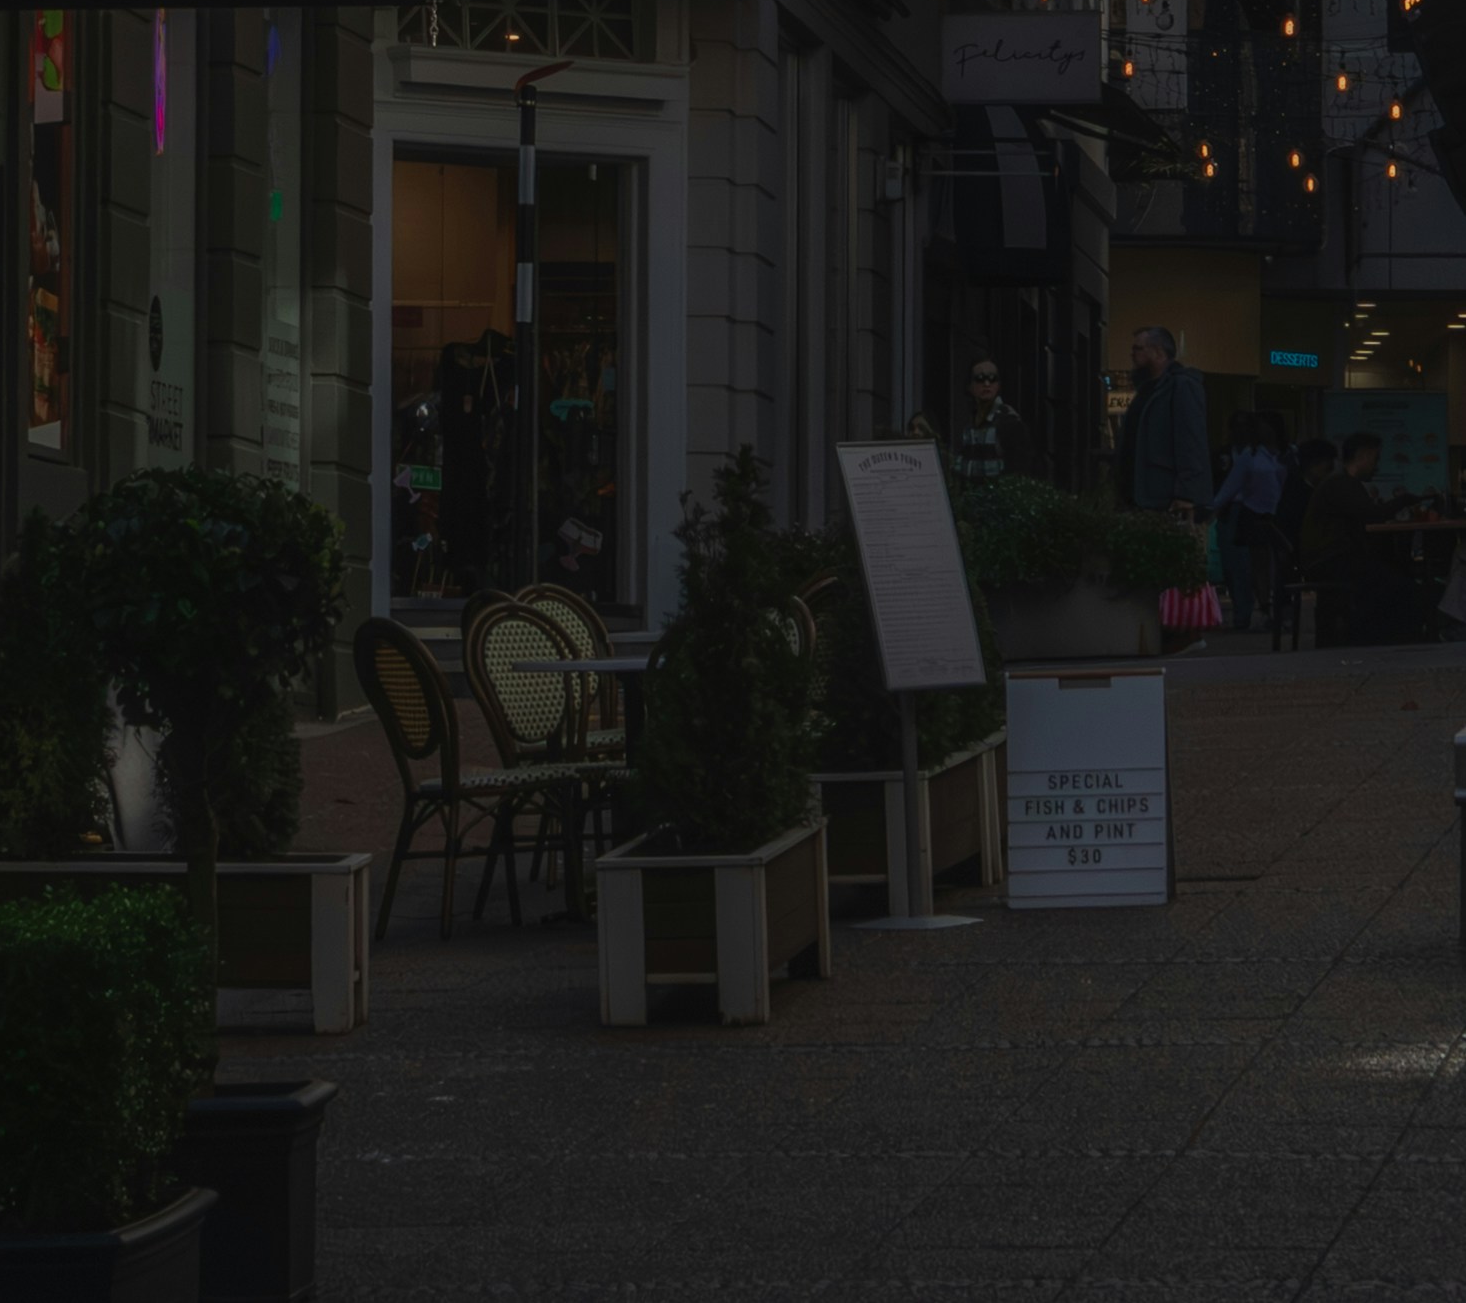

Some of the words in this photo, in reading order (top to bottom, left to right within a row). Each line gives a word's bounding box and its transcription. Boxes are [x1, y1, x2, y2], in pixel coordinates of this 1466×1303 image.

[1047, 772, 1124, 791] SPECIAL
[1024, 799, 1066, 816] FISH
[1072, 798, 1087, 815] &
[1095, 796, 1150, 815] CHIPS
[1045, 823, 1084, 841] AND
[1093, 822, 1138, 840] PINT
[1067, 846, 1103, 866] $30
